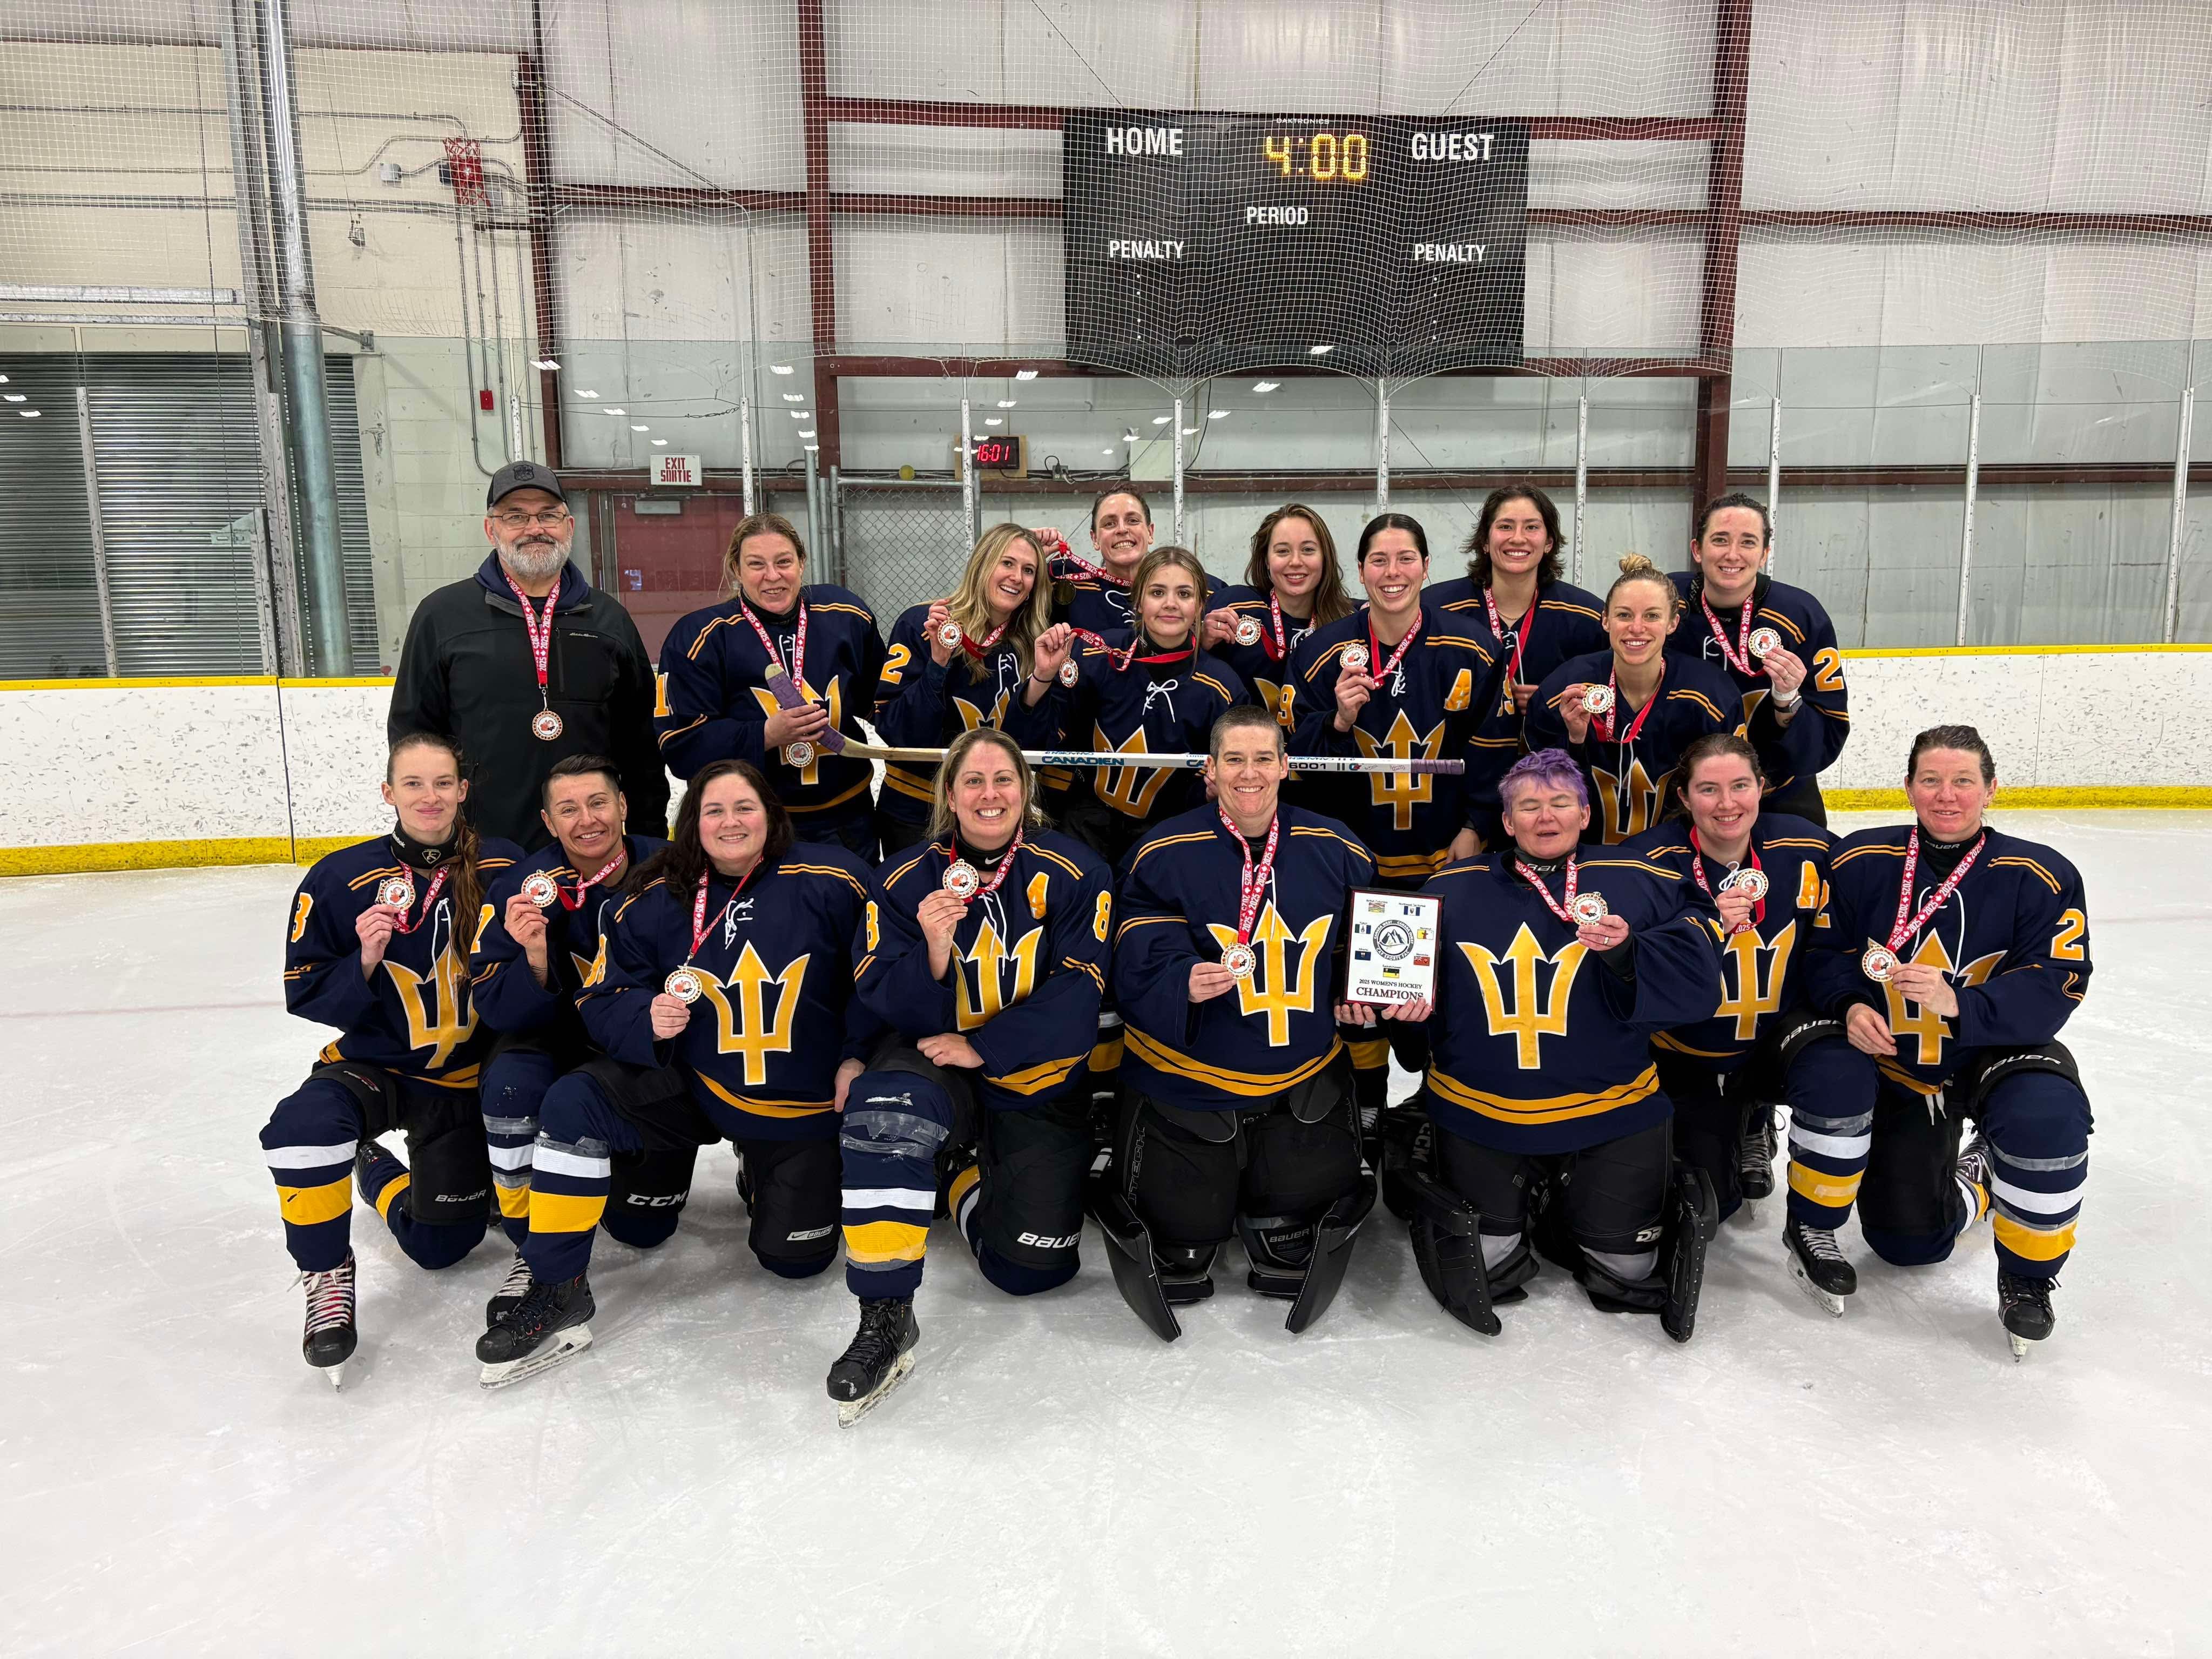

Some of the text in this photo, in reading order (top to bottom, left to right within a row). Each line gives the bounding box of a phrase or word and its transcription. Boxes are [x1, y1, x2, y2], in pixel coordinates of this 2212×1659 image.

[1107, 128, 1183, 156] HOME
[1412, 133, 1495, 161] GUEST
[1265, 133, 1367, 179] 4:00
[1247, 206, 1309, 225] PERIOD
[1110, 240, 1184, 259] PENALTY
[1414, 244, 1486, 262] PENALTY
[976, 444, 1010, 462] 16:01
[665, 457, 686, 470] EXIT
[660, 469, 692, 483] SORTIE
[1069, 554, 1081, 564] 2025
[1085, 564, 1097, 574] 2025
[1103, 573, 1116, 583] 2025
[509, 580, 520, 592] 2025
[526, 613, 536, 628] 2025
[543, 614, 551, 628] 2025
[1742, 611, 1751, 624] 2025
[1712, 622, 1722, 635] 2025
[530, 635, 540, 649] 2025
[541, 635, 549, 650] 2025
[757, 628, 769, 642] 2025
[769, 648, 778, 662] 2025
[1080, 632, 1094, 644] 2025
[1739, 632, 1748, 646] 2025
[795, 645, 804, 659] 2025
[880, 643, 912, 685] 2
[1813, 646, 1845, 692] 2
[1444, 668, 1472, 711] A
[1606, 715, 1614, 730] 2025
[1041, 756, 1125, 766] CANADIEN
[994, 873, 1004, 886] 2025
[1003, 853, 1015, 866] 2025
[1015, 832, 1023, 845] 2025
[1905, 856, 1916, 871] 2025
[431, 878, 442, 891] 2025
[1242, 916, 1253, 933] 2025
[1249, 893, 1260, 910] 2025
[1256, 872, 1267, 887] 2025
[1268, 831, 1278, 846] 2025
[1901, 879, 1912, 895] 2025
[1891, 844, 1982, 950] 2025 2025 2025 2025 2025 2025
[291, 892, 313, 943] 3
[1092, 890, 1111, 942] 8
[1897, 903, 1908, 919] 2025
[469, 904, 495, 954] 7
[2050, 908, 2086, 961] 2
[1356, 987, 1424, 1000] CHAMPIONS
[626, 1193, 687, 1206] CCM
[1269, 1228, 1310, 1243] BAUER
